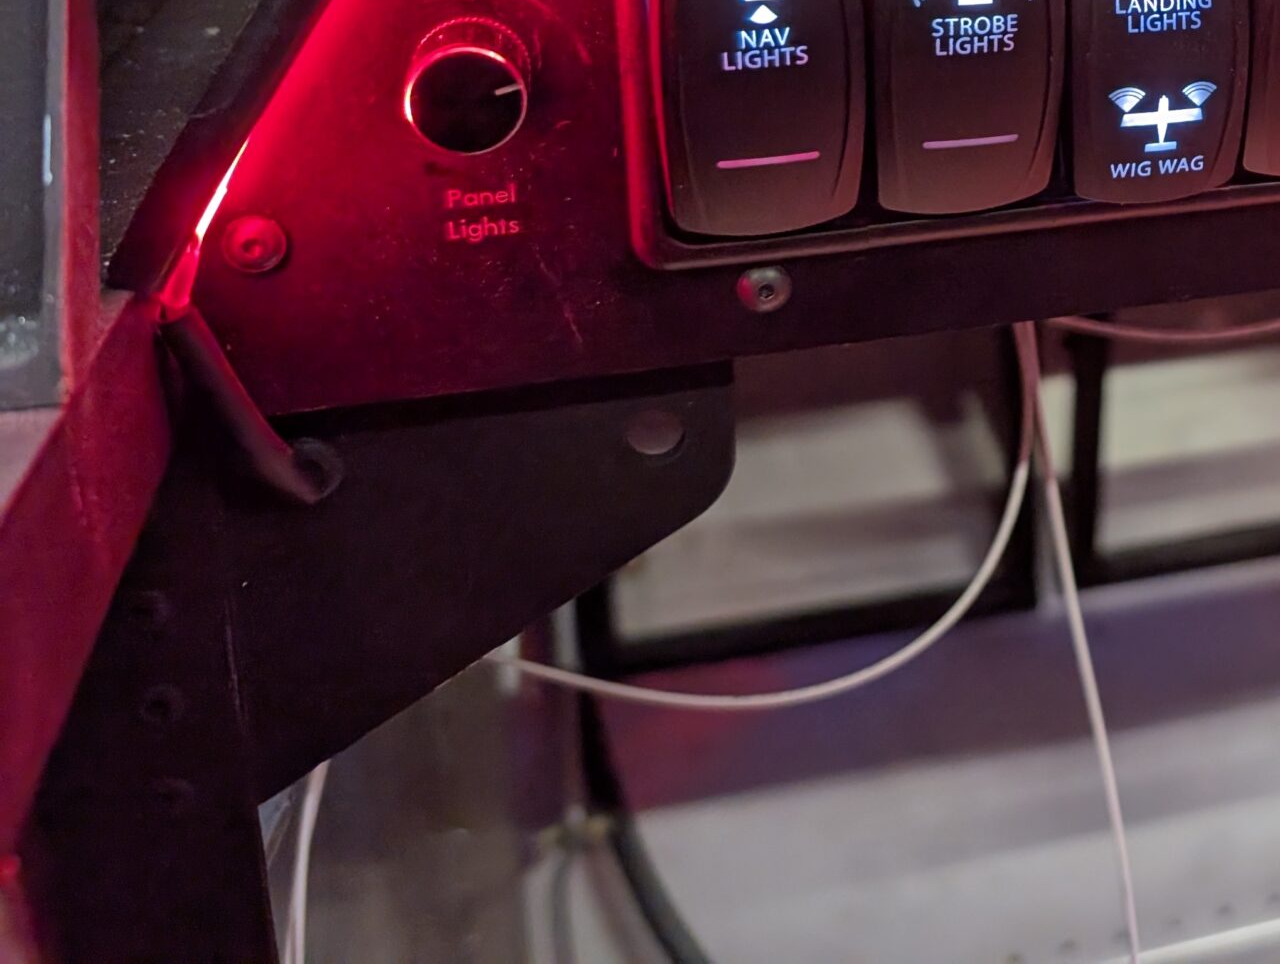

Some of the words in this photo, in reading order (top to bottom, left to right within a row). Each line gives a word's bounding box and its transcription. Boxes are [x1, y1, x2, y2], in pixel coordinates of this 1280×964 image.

[931, 14, 1018, 37] STROBE
[1127, 11, 1201, 34] LIGHTS
[740, 27, 790, 49] NAV
[935, 34, 1015, 56] LIGHTS
[722, 45, 809, 71] LIGHTS
[1109, 160, 1152, 179] WIG
[1158, 155, 1205, 174] WAG
[447, 183, 517, 209] Panel
[447, 216, 520, 243] Lights
